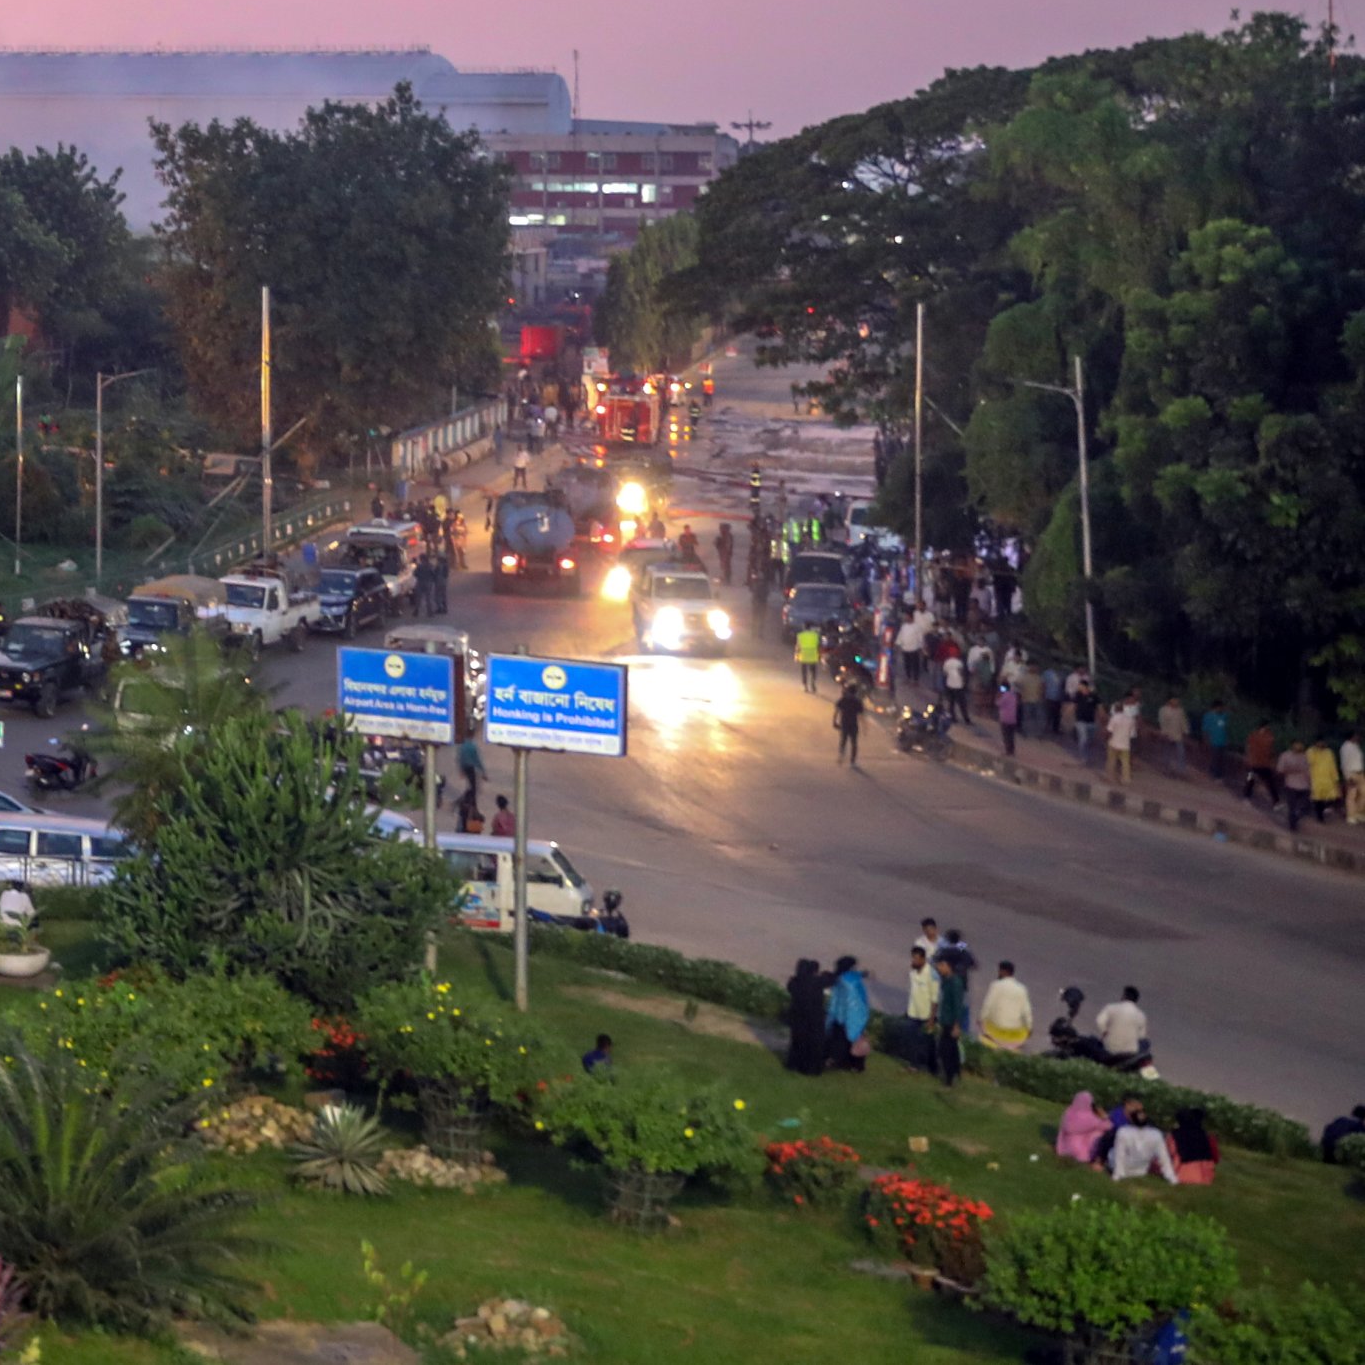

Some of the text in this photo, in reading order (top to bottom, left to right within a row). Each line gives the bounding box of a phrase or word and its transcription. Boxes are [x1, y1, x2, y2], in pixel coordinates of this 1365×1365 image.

[344, 696, 374, 707] Airport
[375, 699, 394, 709] Area
[396, 701, 405, 712] is
[518, 690, 570, 708] বাজানো
[574, 690, 615, 712] নিষেধ
[493, 706, 615, 729] Honking is Prohibited
